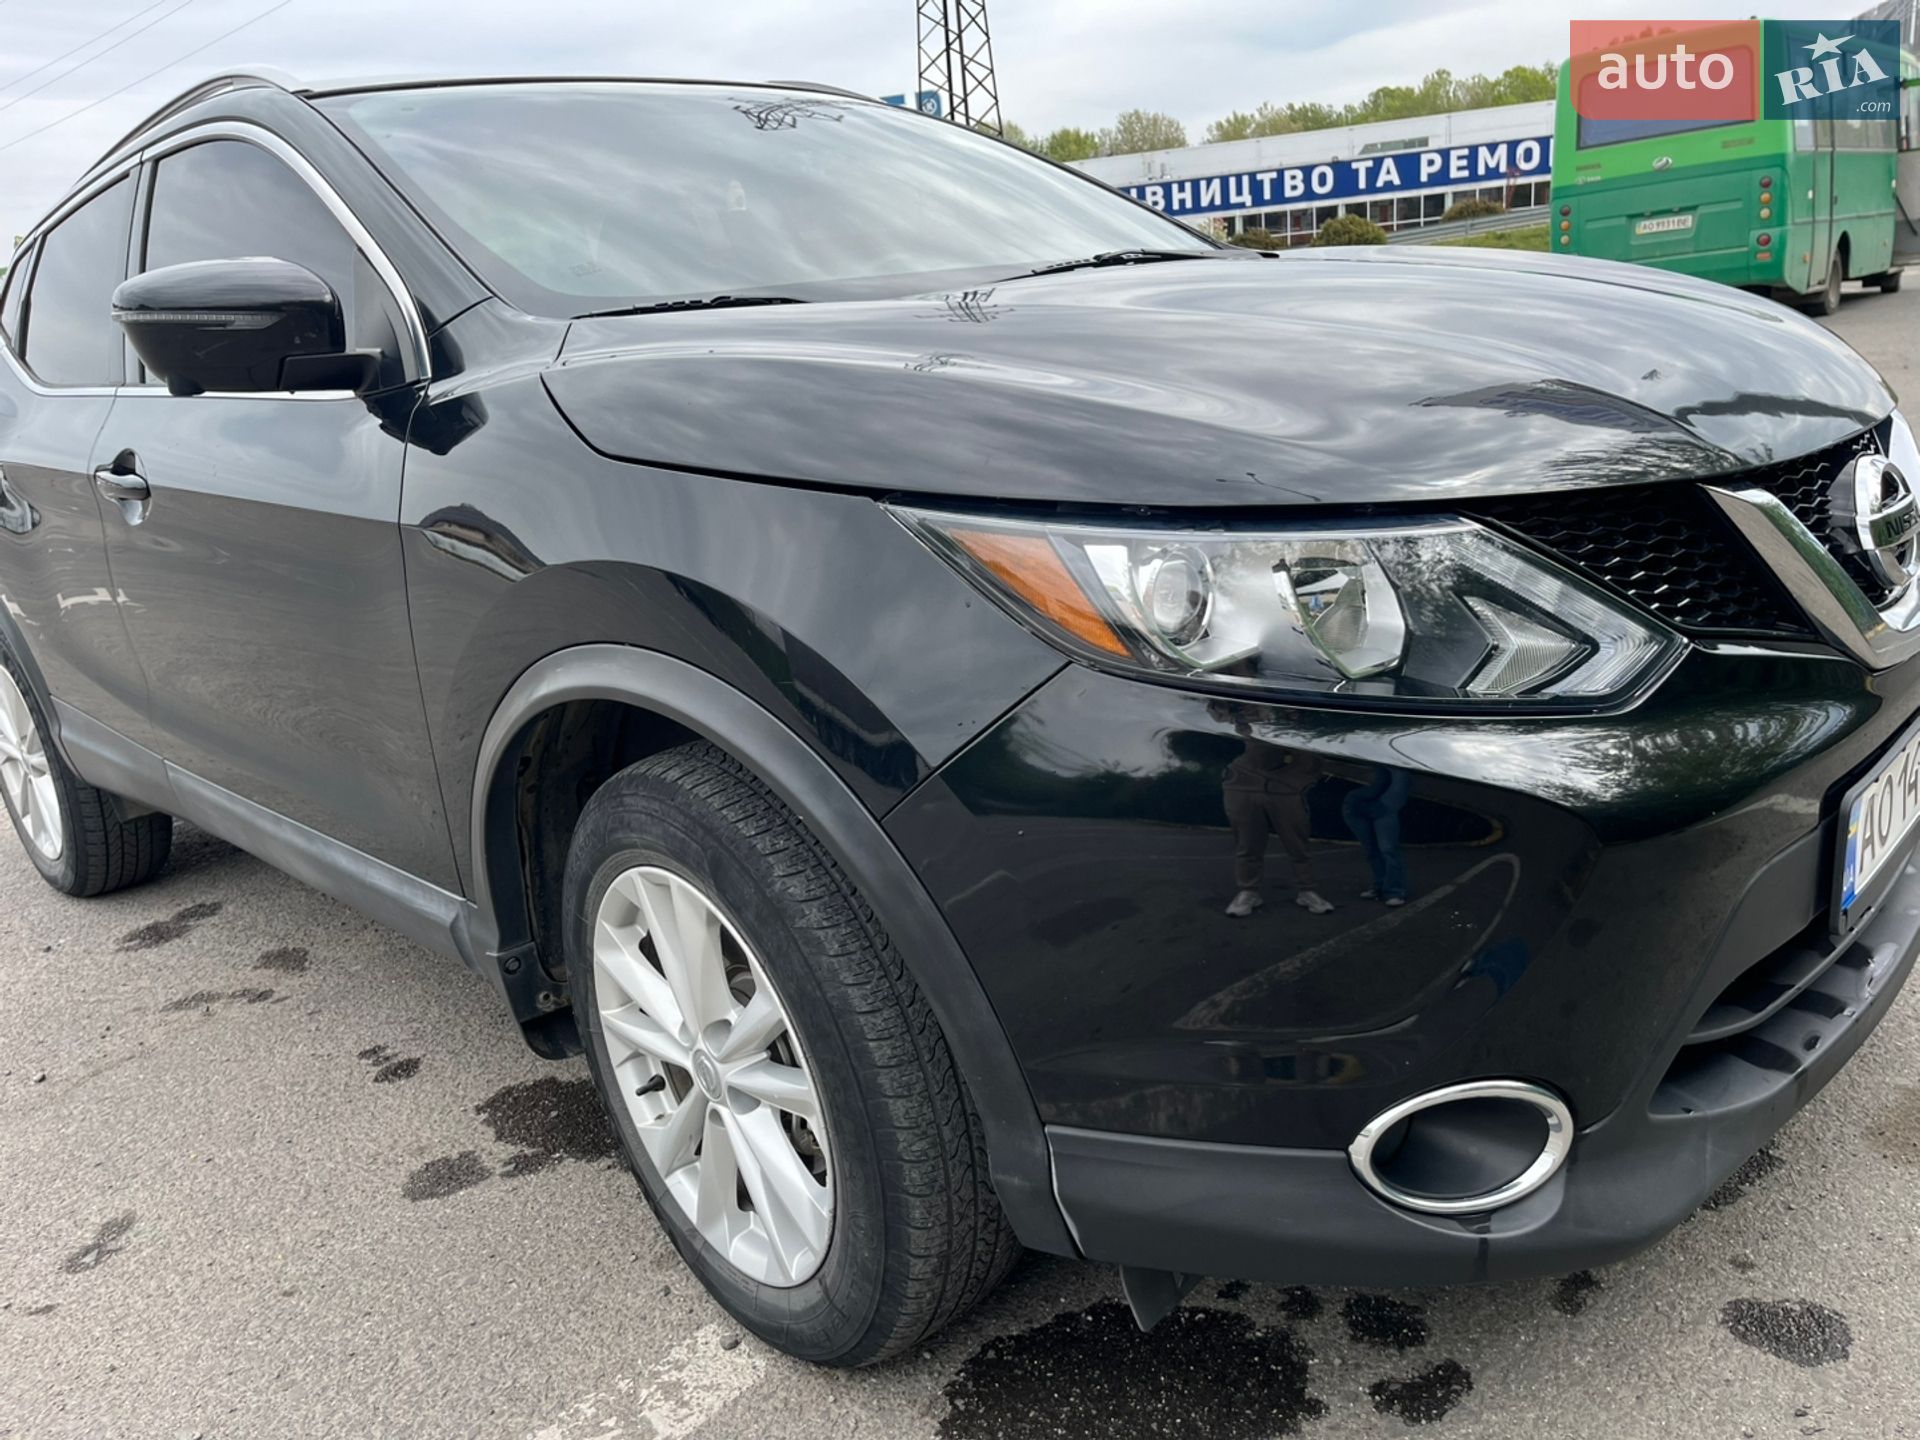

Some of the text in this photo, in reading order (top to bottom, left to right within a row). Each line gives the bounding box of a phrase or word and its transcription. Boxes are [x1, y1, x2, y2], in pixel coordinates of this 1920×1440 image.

[1351, 157, 1401, 190] ТА
[1420, 138, 1553, 183] РЕМО
[1860, 741, 1920, 873] AO 14
